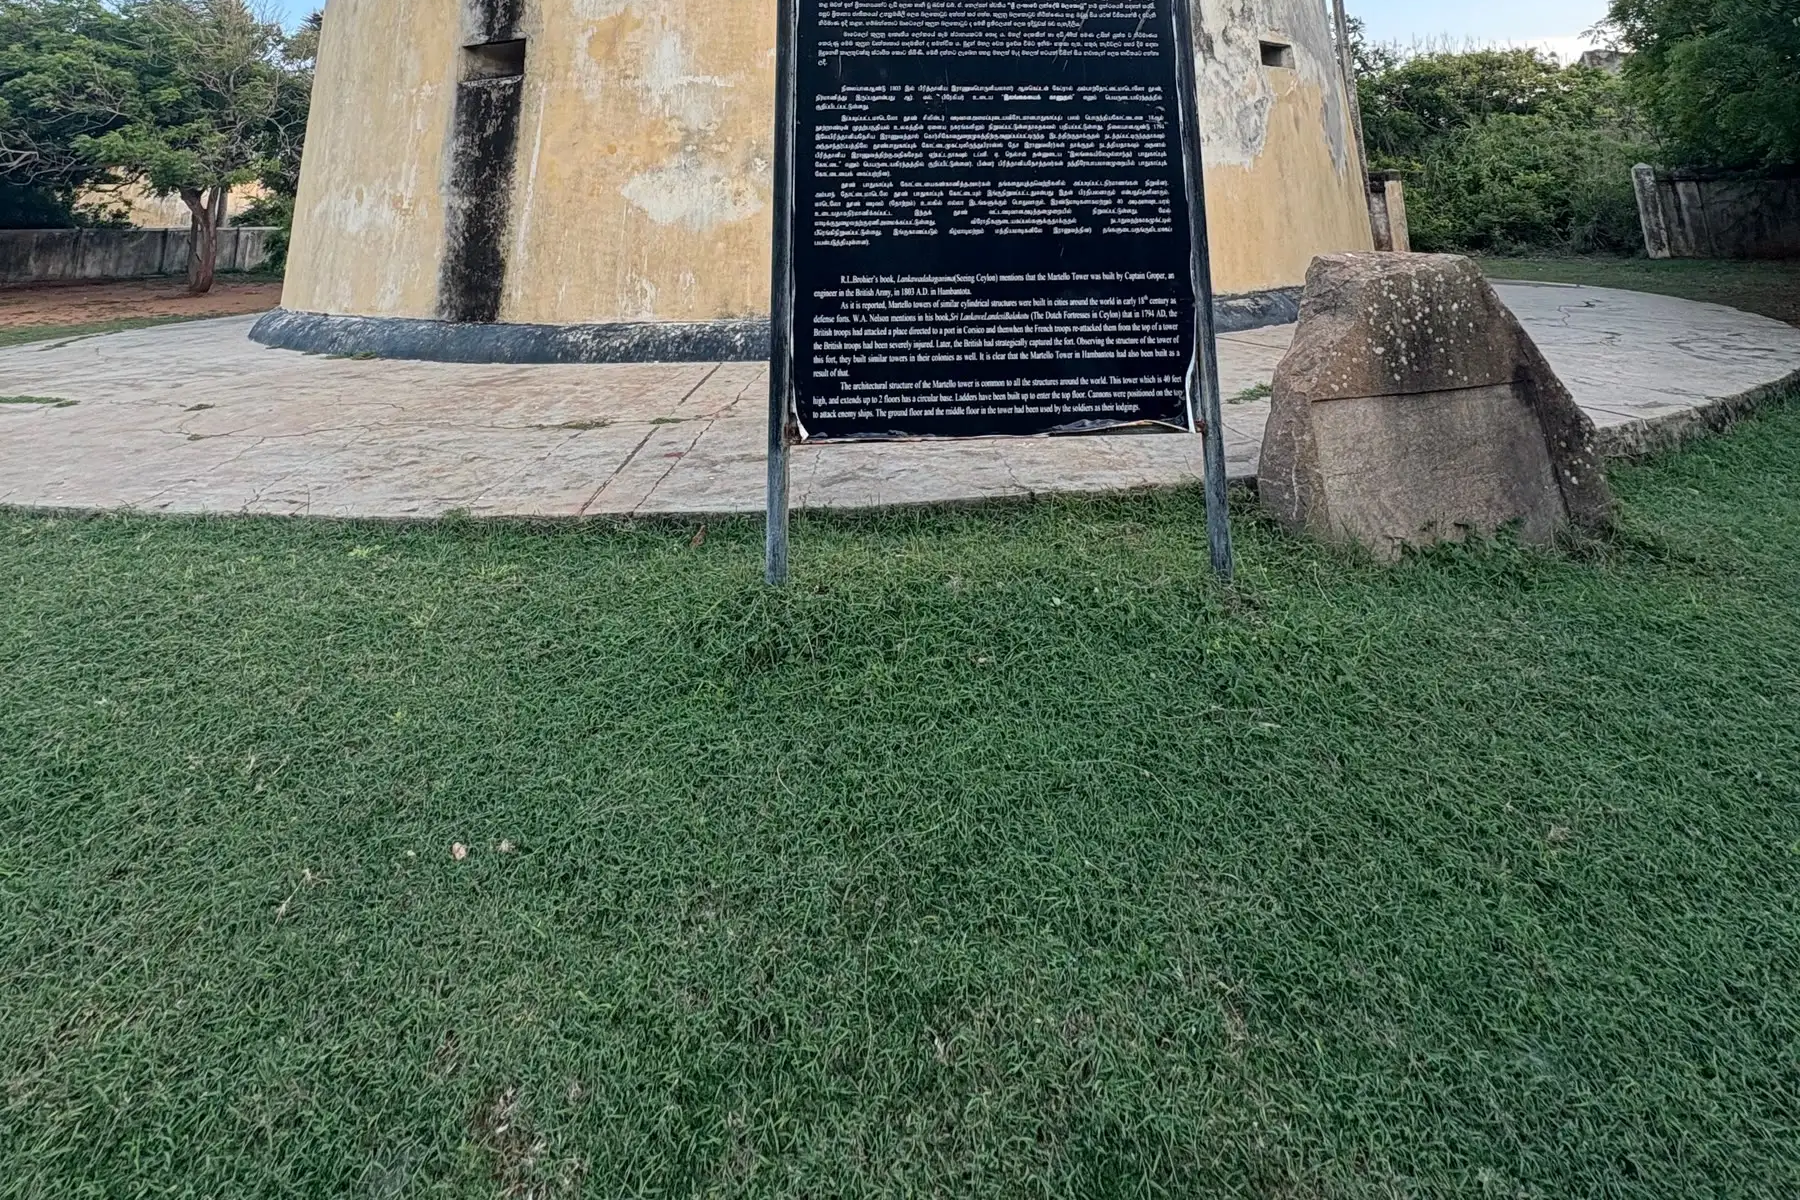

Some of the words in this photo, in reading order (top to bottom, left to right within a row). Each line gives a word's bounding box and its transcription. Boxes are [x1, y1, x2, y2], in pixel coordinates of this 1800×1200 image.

[879, 275, 896, 284] book,
[975, 274, 998, 283] Ceylon)
[1025, 273, 1036, 281] that
[1036, 273, 1046, 281] the
[1047, 273, 1070, 281] Martello
[1115, 273, 1123, 282] by
[1124, 272, 1145, 282] Captain
[813, 289, 837, 298] engineer
[855, 288, 874, 296] British
[874, 288, 894, 297] Army,
[893, 288, 900, 296] in
[901, 288, 915, 296] 1803
[855, 300, 861, 308] is
[861, 300, 887, 309] reported,
[888, 300, 912, 308] Martello
[960, 299, 989, 308] cylindrical
[1053, 298, 1068, 306] cities
[1069, 298, 1088, 306] around
[1089, 298, 1098, 306] the
[1122, 298, 1136, 307] early
[1148, 297, 1169, 307] century
[852, 314, 868, 322] W.A.
[917, 313, 923, 321] in
[924, 313, 934, 321] his
[1030, 312, 1044, 321] (The
[1063, 311, 1090, 319] Fortresses
[1091, 311, 1098, 319] in
[1098, 311, 1121, 320] Ceylon)
[1133, 310, 1140, 318] in
[1141, 310, 1154, 318] 1794
[1168, 310, 1177, 318] the
[812, 355, 824, 363] this
[825, 355, 838, 364] fort,
[838, 355, 851, 364] they
[852, 354, 866, 362] built
[867, 354, 887, 362] similar
[916, 353, 930, 361] their
[931, 353, 955, 361] colonies
[985, 352, 991, 360] is
[991, 352, 1006, 360] clear
[1007, 352, 1018, 360] that
[1055, 351, 1073, 359] Tower
[1074, 351, 1080, 359] in
[1115, 350, 1126, 358] had
[1127, 350, 1139, 358] also
[1140, 350, 1153, 358] been
[812, 369, 829, 377] result
[829, 369, 837, 377] of
[837, 369, 850, 377] that.
[852, 381, 887, 389] architectural
[914, 380, 922, 388] of
[921, 380, 931, 388] the
[974, 379, 980, 387] is
[1021, 378, 1031, 386] the
[1031, 378, 1058, 386] structures
[1079, 377, 1089, 385] the
[1089, 377, 1108, 385] world.
[1139, 376, 1156, 384] which
[812, 410, 819, 418] to
[857, 409, 874, 418] ships.
[887, 408, 908, 417] ground
[935, 407, 944, 415] the
[945, 407, 965, 415] middle
[987, 406, 996, 414] the
[996, 406, 1013, 414] tower
[1039, 405, 1053, 413] used
[1053, 405, 1061, 414] by
[1101, 404, 1114, 412] their
[1115, 404, 1140, 413] lodgings.
